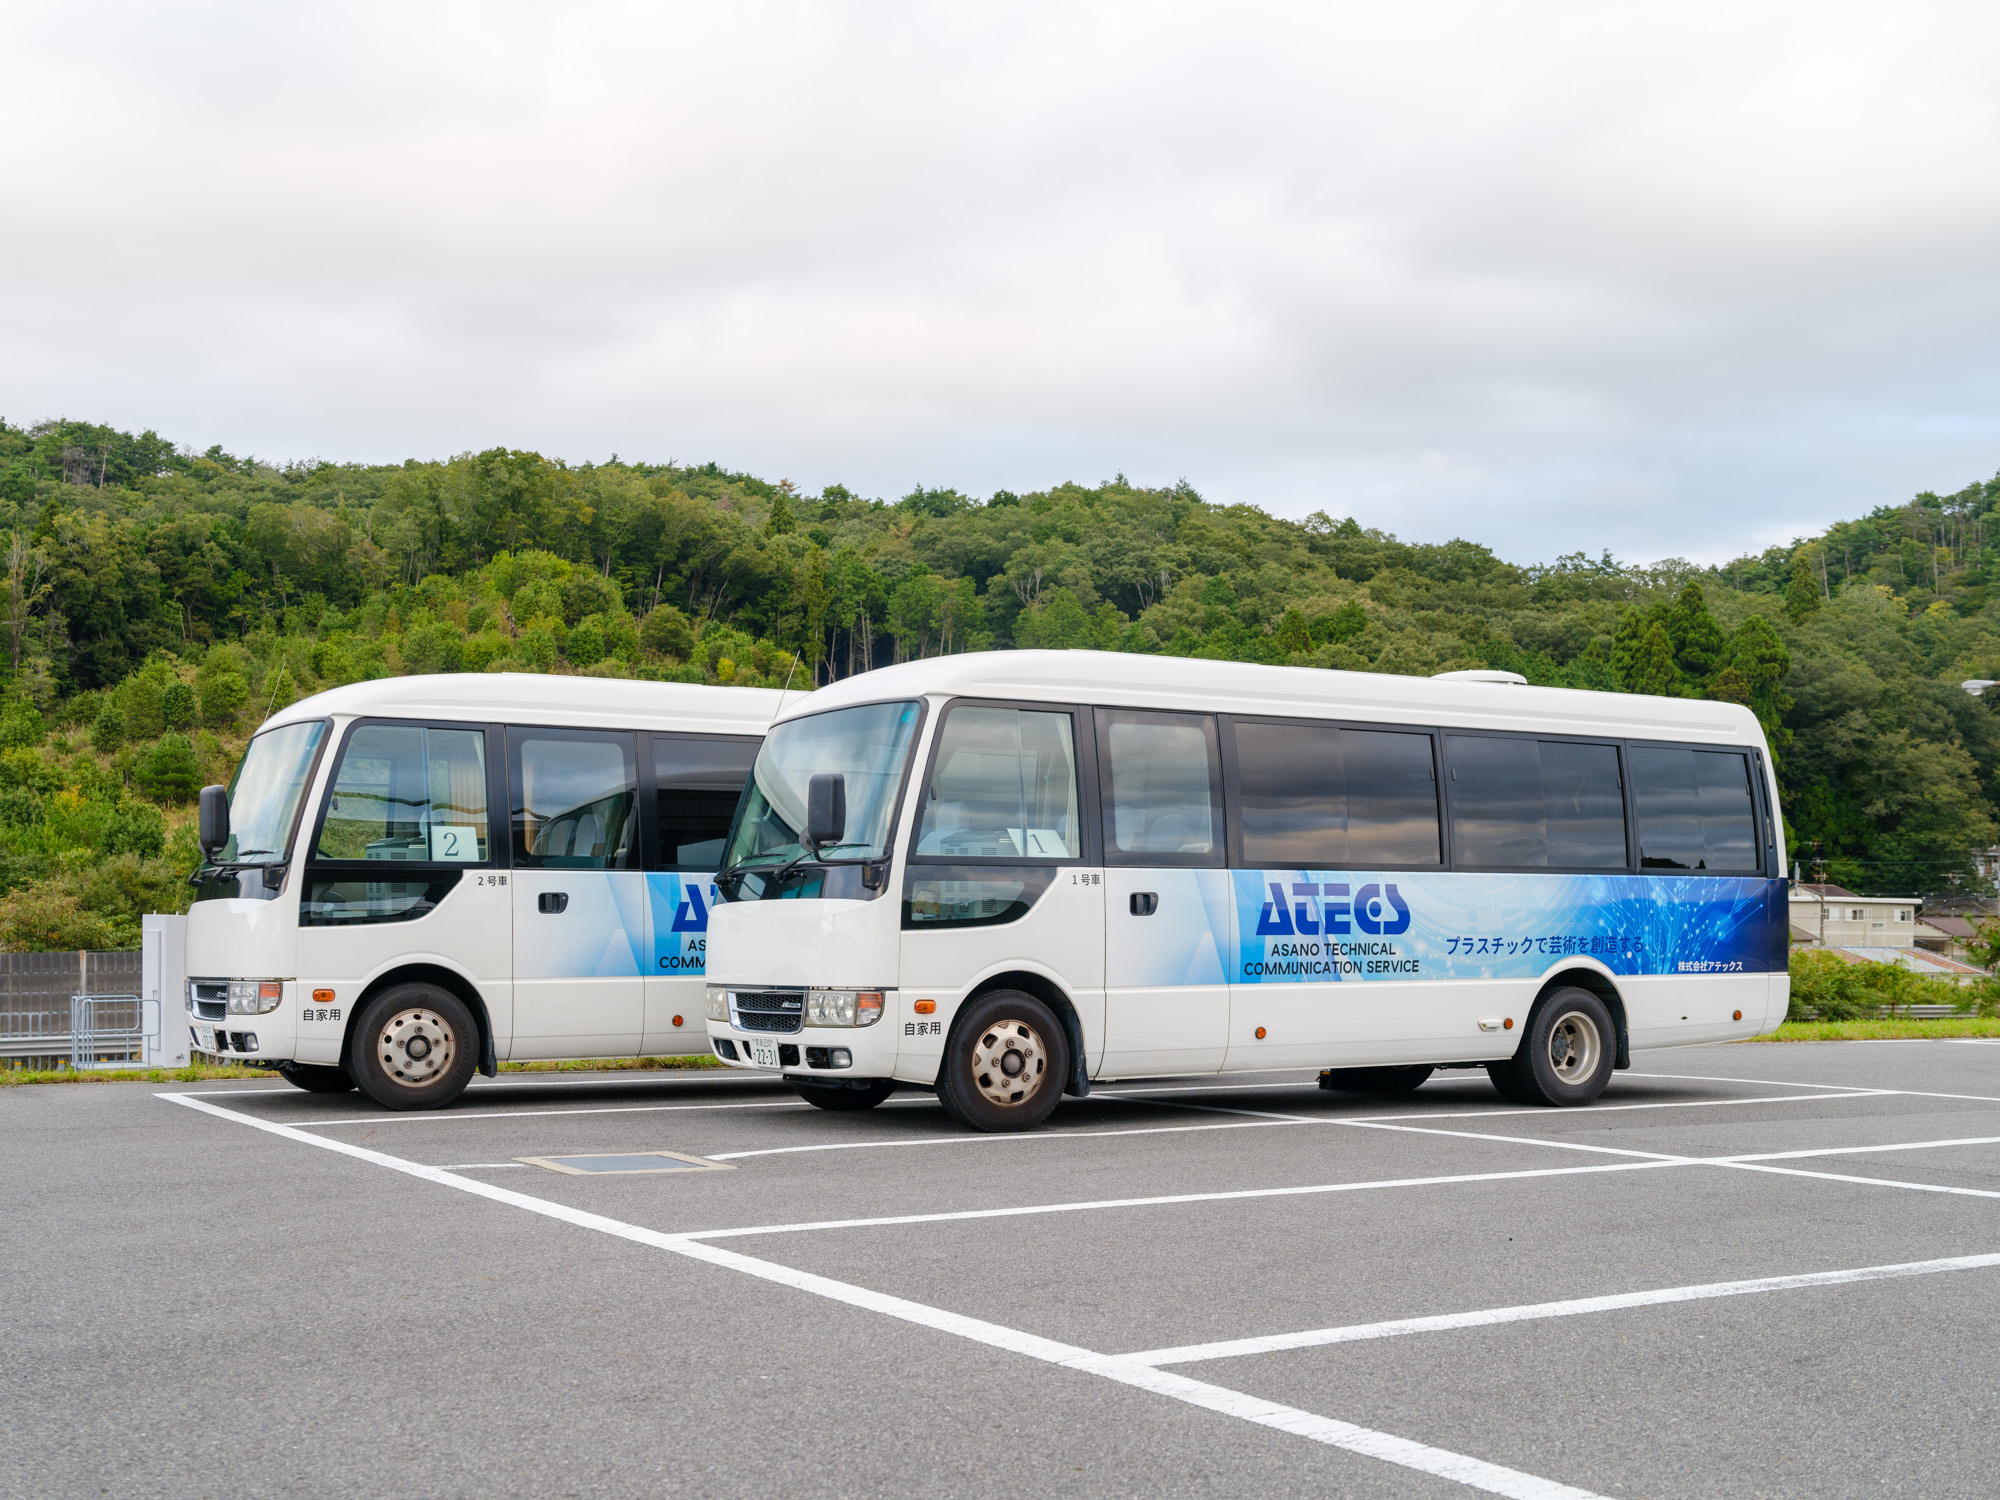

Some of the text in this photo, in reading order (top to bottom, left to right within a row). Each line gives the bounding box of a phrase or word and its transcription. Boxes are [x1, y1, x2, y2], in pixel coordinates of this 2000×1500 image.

[443, 832, 460, 857] 2
[1028, 833, 1049, 854] 1
[477, 875, 508, 887] 2号車
[1072, 873, 1101, 886] 1号車
[1256, 883, 1411, 935] ATECS
[1271, 943, 1396, 956] ASANO TECHNICAL
[1446, 935, 1644, 956] プラスチックで芸術を創造する
[1244, 960, 1419, 975] COMMUNICATION SERVICE
[1677, 960, 1743, 972] 株式会社アテックス
[303, 1008, 341, 1022] 自家用
[904, 1021, 941, 1036] 自家用
[756, 1048, 778, 1066] 22-31
